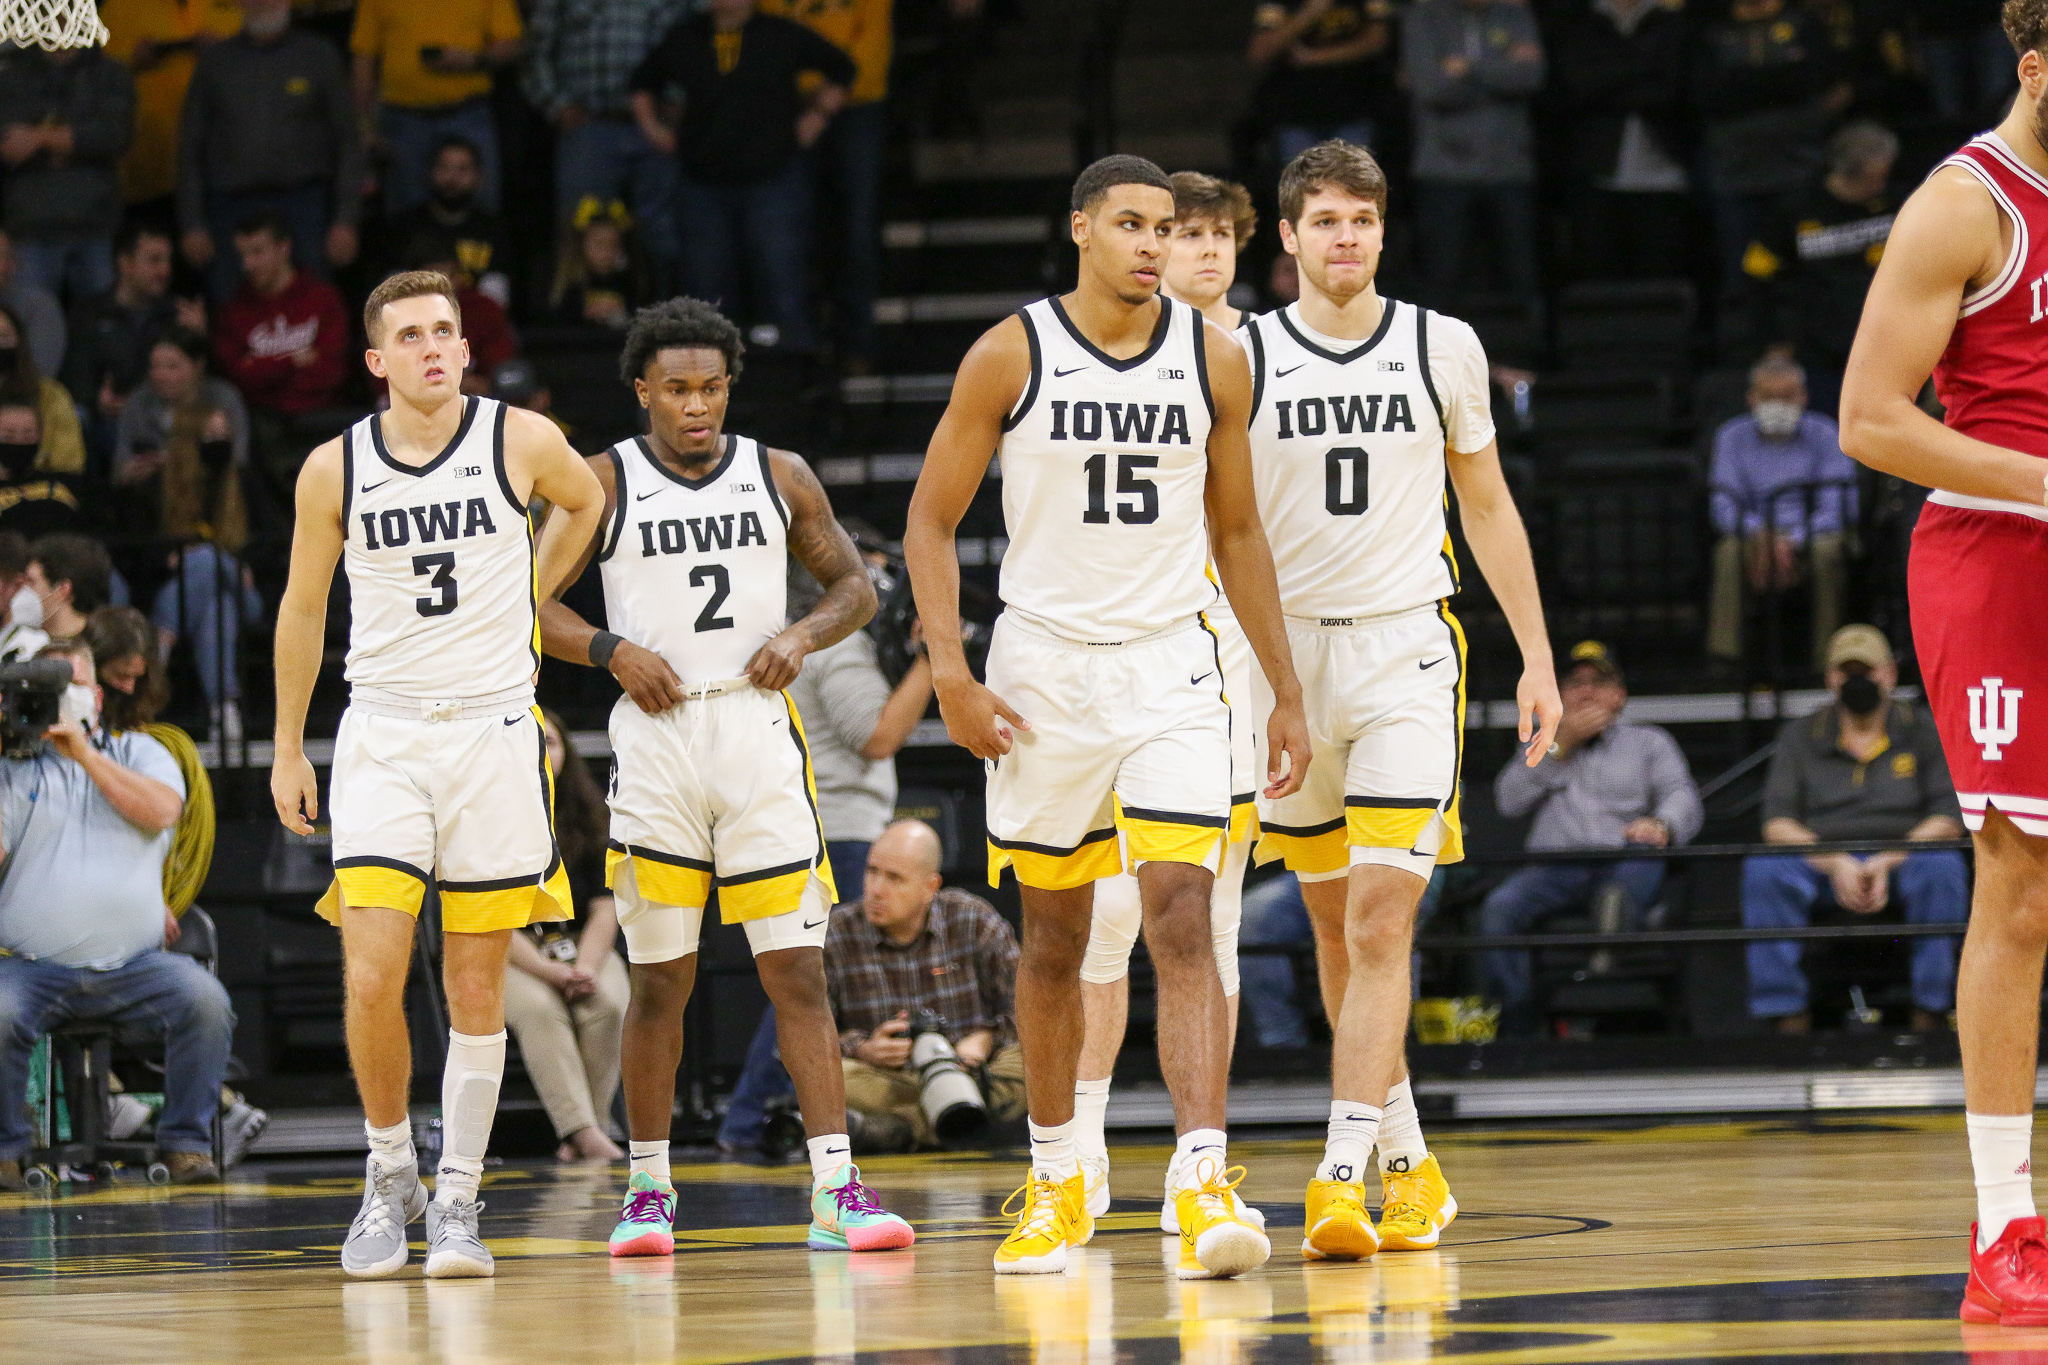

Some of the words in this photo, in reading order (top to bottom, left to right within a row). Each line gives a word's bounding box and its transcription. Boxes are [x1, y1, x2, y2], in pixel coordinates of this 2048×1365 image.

[1050, 400, 1192, 445] IOWA
[1275, 394, 1416, 440] IOWA
[1083, 453, 1160, 525] 15
[1325, 446, 1369, 516] 0
[360, 497, 497, 551] IOWA
[637, 511, 768, 558] IOWA
[411, 551, 459, 618] 3
[688, 563, 734, 633] 2
[1320, 618, 1353, 627] HAWKS
